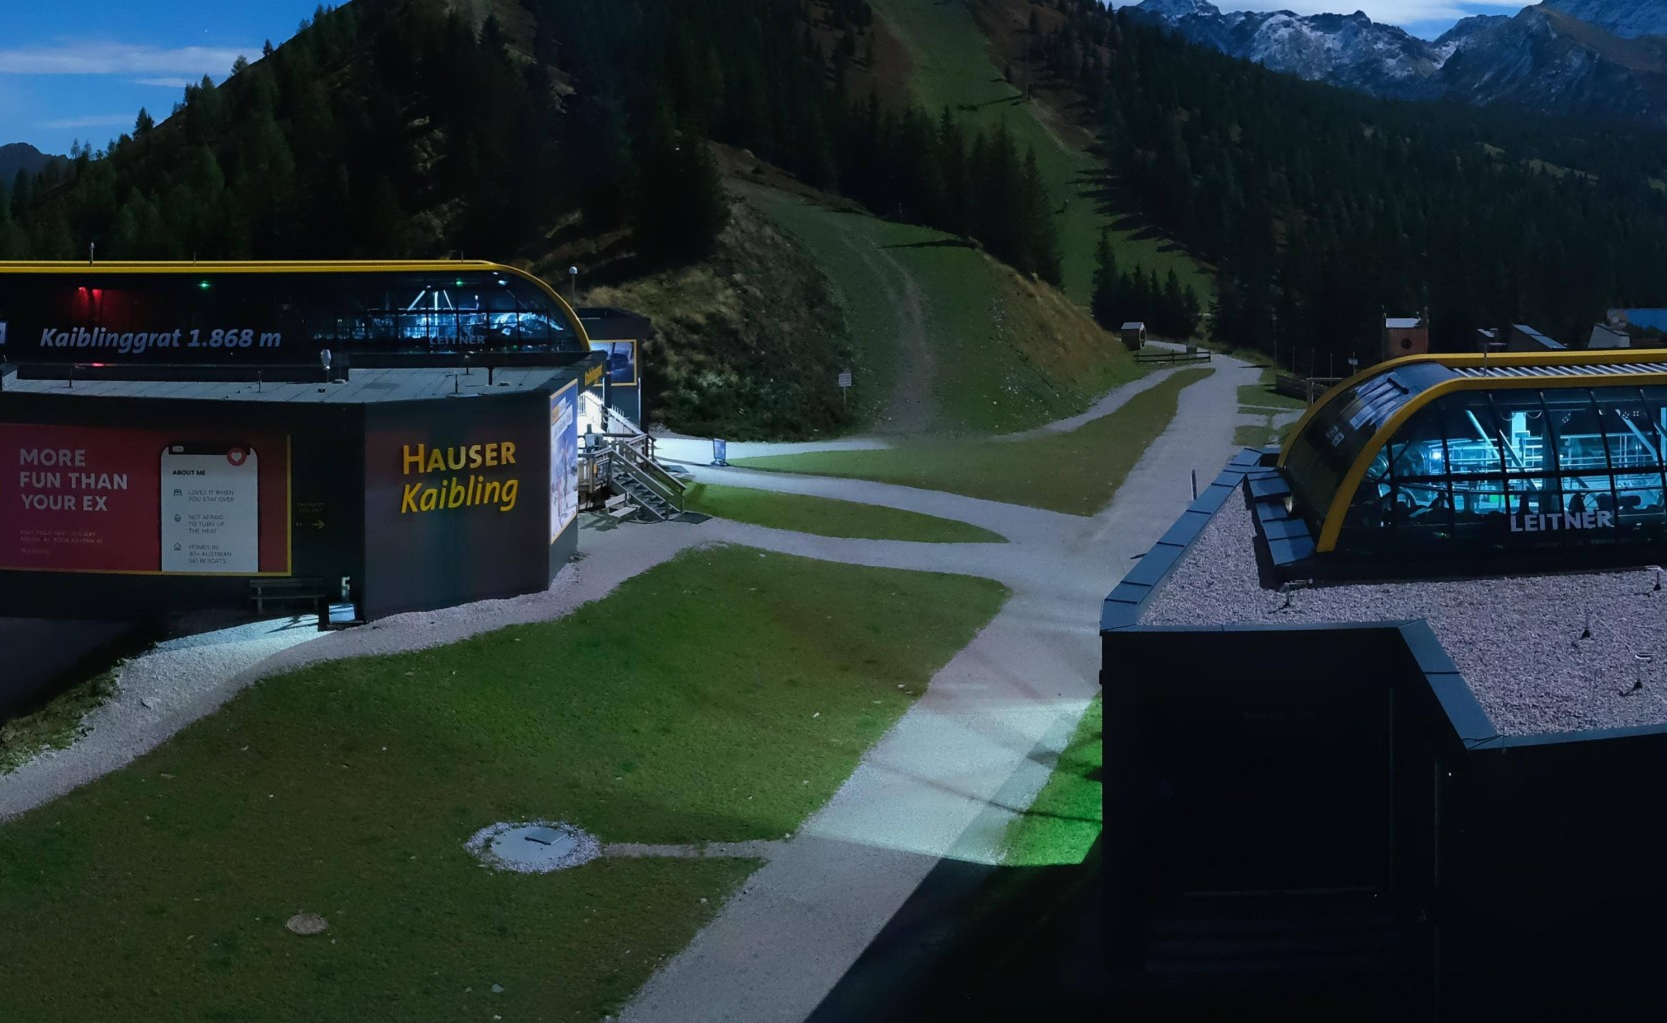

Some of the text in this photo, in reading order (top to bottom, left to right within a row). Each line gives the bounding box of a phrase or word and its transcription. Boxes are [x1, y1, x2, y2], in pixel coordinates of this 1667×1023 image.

[40, 327, 282, 354] Kaiblinggrat 1.868 m
[429, 335, 486, 345] LEITNER
[19, 448, 86, 467] MORE
[402, 441, 517, 475] HAUSER
[19, 471, 128, 490] FUN THAN
[20, 493, 108, 511] YOUR EX
[401, 474, 519, 514] Kaibling
[1510, 510, 1615, 533] LEITNER
